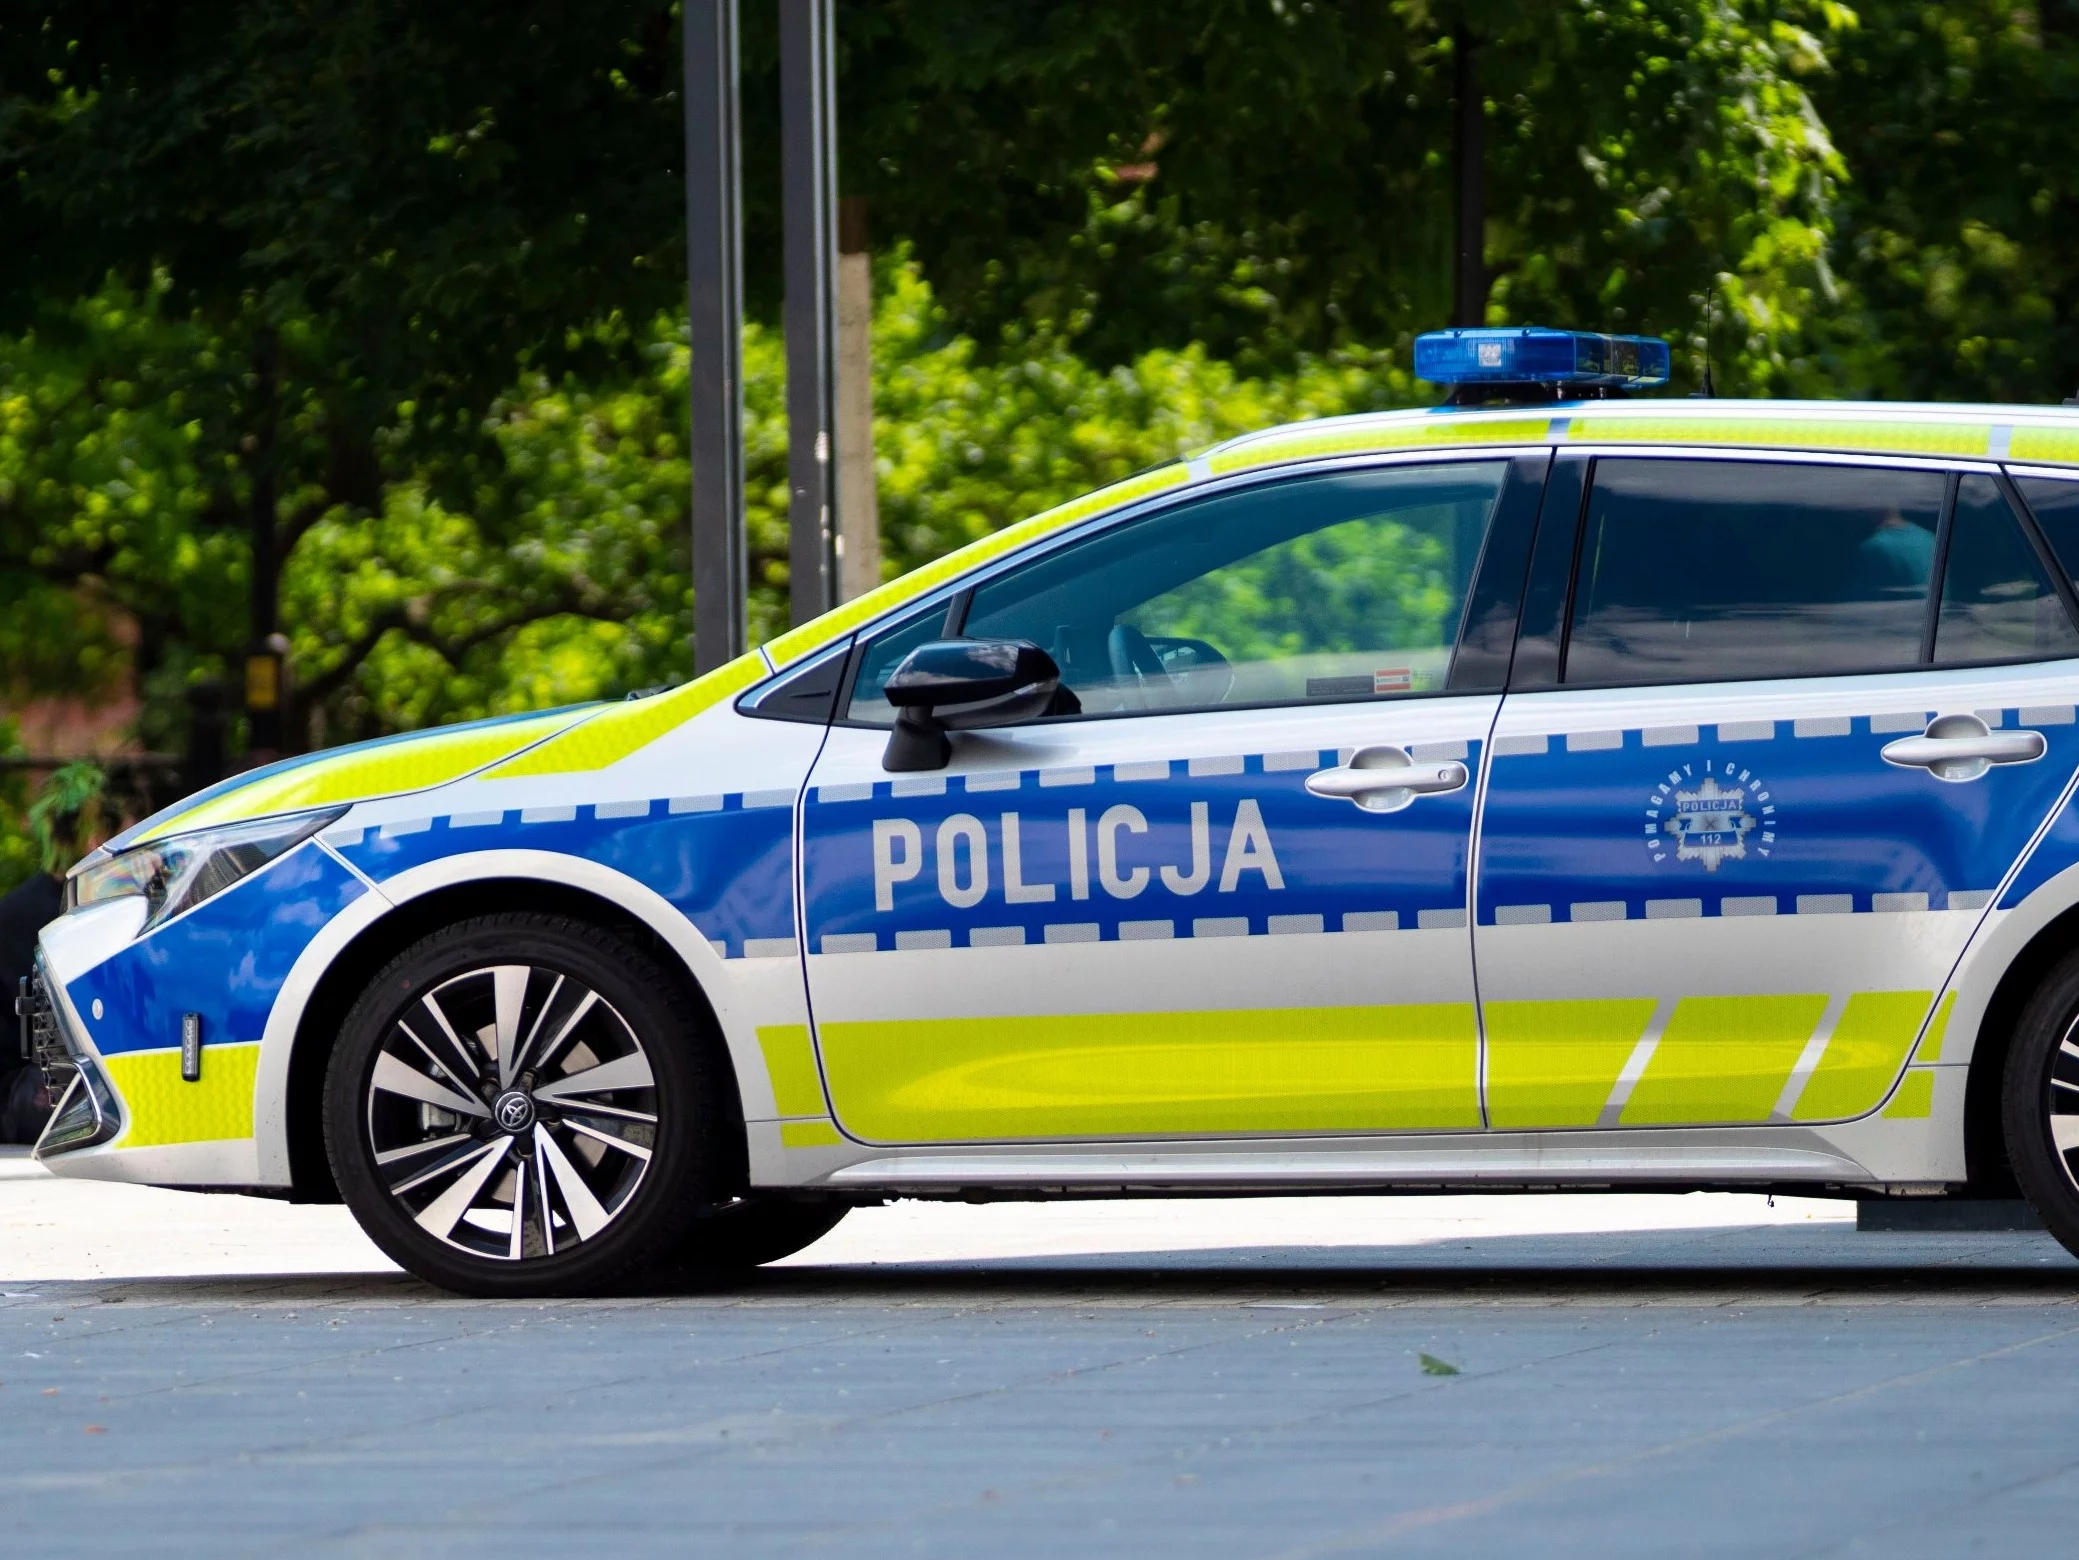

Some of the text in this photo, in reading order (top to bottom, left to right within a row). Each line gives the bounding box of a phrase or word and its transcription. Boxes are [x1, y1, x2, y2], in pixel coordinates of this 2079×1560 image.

[1645, 760, 1776, 862] POMAGAMY I CHRONIMY
[1683, 801, 1737, 812] POLICJA
[873, 799, 1285, 911] POLICJA
[1700, 834, 1721, 845] 112
